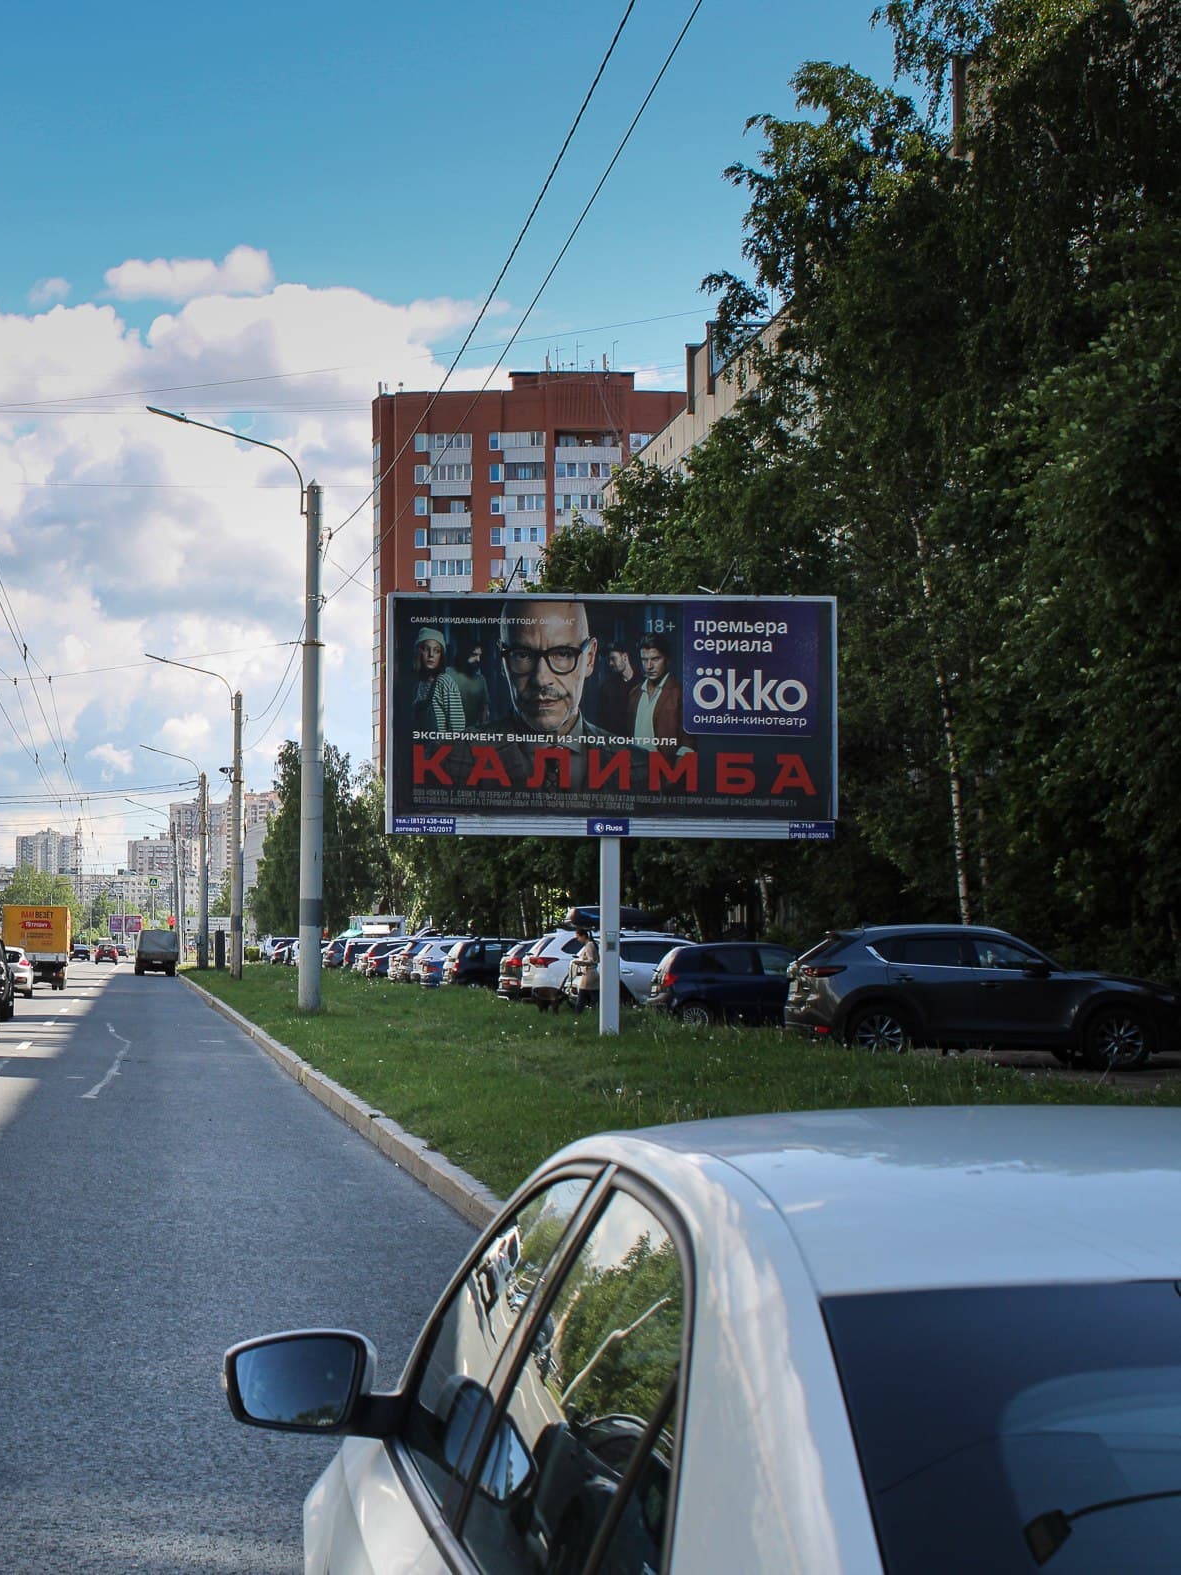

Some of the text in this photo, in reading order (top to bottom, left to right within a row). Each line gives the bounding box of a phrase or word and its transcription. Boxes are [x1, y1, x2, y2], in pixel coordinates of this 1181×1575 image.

[410, 616, 437, 624] САМЫЙ
[438, 616, 486, 625] ОЖИДАЕМЫЙ
[646, 619, 676, 633] 18+
[694, 619, 788, 637] премьера
[693, 638, 773, 655] сериала
[693, 713, 808, 728] онлайн-кинотеатр
[412, 731, 678, 746] ЭКСПЕРИМЕНТ ВЫШЕЛ ИЗ-ПОД КОНТРОЛЯ
[412, 744, 817, 795] КАЛИМБА
[605, 824, 624, 832] Russ
